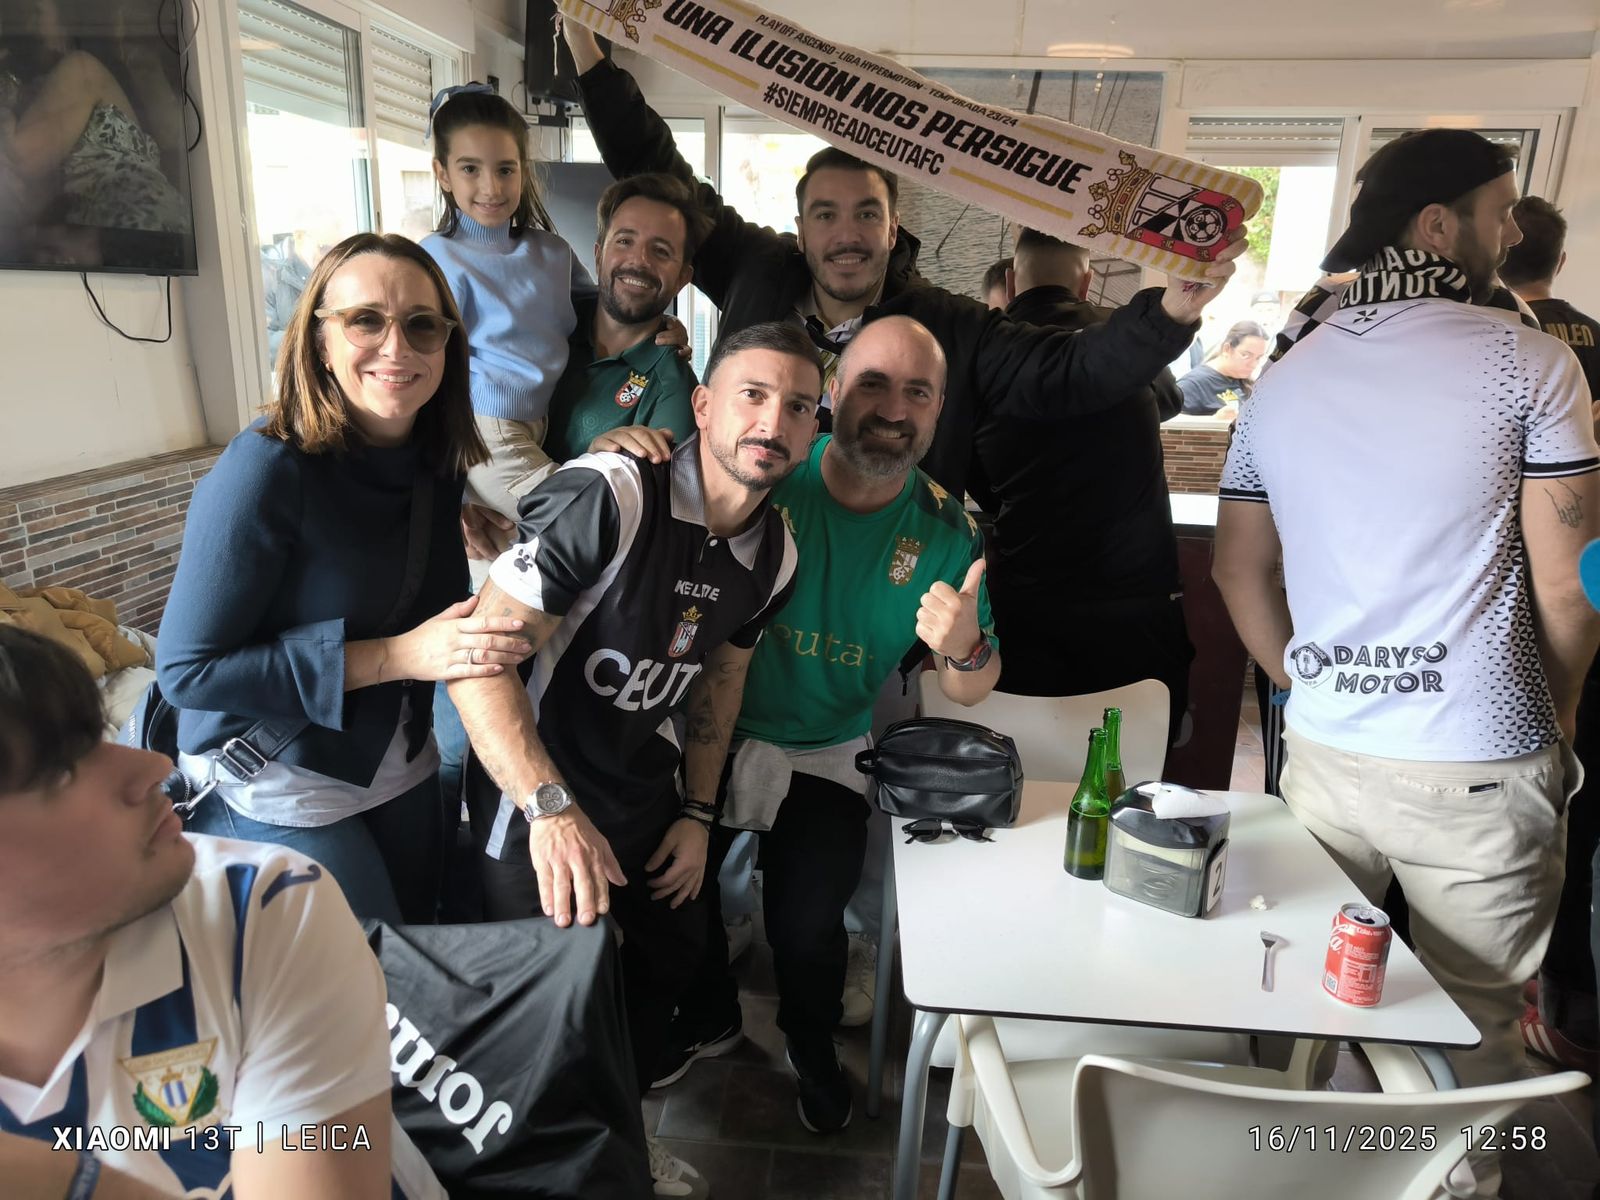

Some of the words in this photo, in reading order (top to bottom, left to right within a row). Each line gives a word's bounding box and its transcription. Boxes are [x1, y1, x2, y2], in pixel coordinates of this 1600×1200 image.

[663, 0, 734, 46] UNA
[729, 28, 861, 103] ILUSIÓN
[850, 81, 929, 130] NOS
[919, 109, 1093, 195] PERSIGUE
[795, 32, 836, 55] ASCENSO
[860, 60, 924, 90] HYPERMOTION
[928, 88, 987, 116] TEMPORADA
[986, 108, 1019, 127] 23/24
[763, 81, 945, 176] #SIEMPREADCEUTAFC
[584, 648, 703, 711] CEUT
[1333, 641, 1448, 669] DARYSO
[1334, 670, 1445, 694] MOTOR
[1212, 862, 1223, 897] 2
